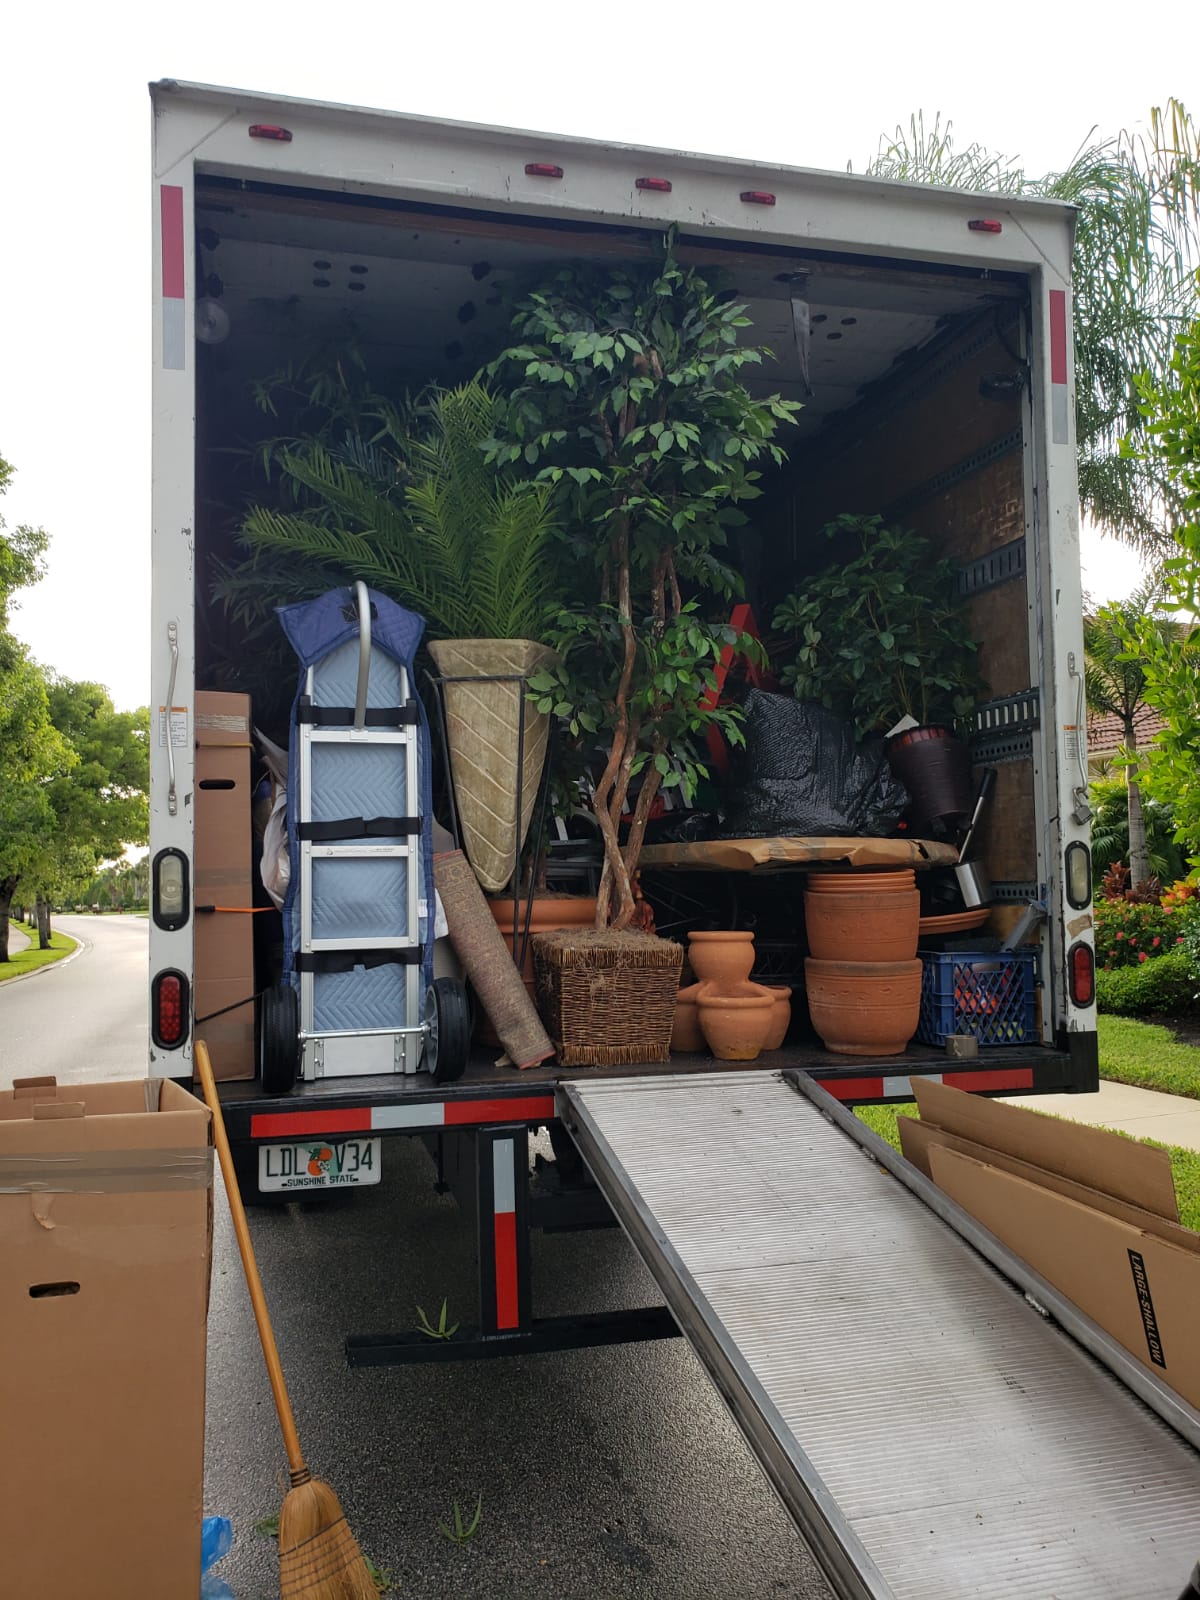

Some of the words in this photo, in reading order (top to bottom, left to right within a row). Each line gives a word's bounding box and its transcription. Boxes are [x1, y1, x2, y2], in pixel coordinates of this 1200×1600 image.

[266, 1147, 306, 1178] LDL
[335, 1142, 373, 1173] V34
[287, 1176, 326, 1187] SUNSHINE
[329, 1174, 354, 1184] STATE
[1131, 1255, 1162, 1364] LARGE-SHALLOW
